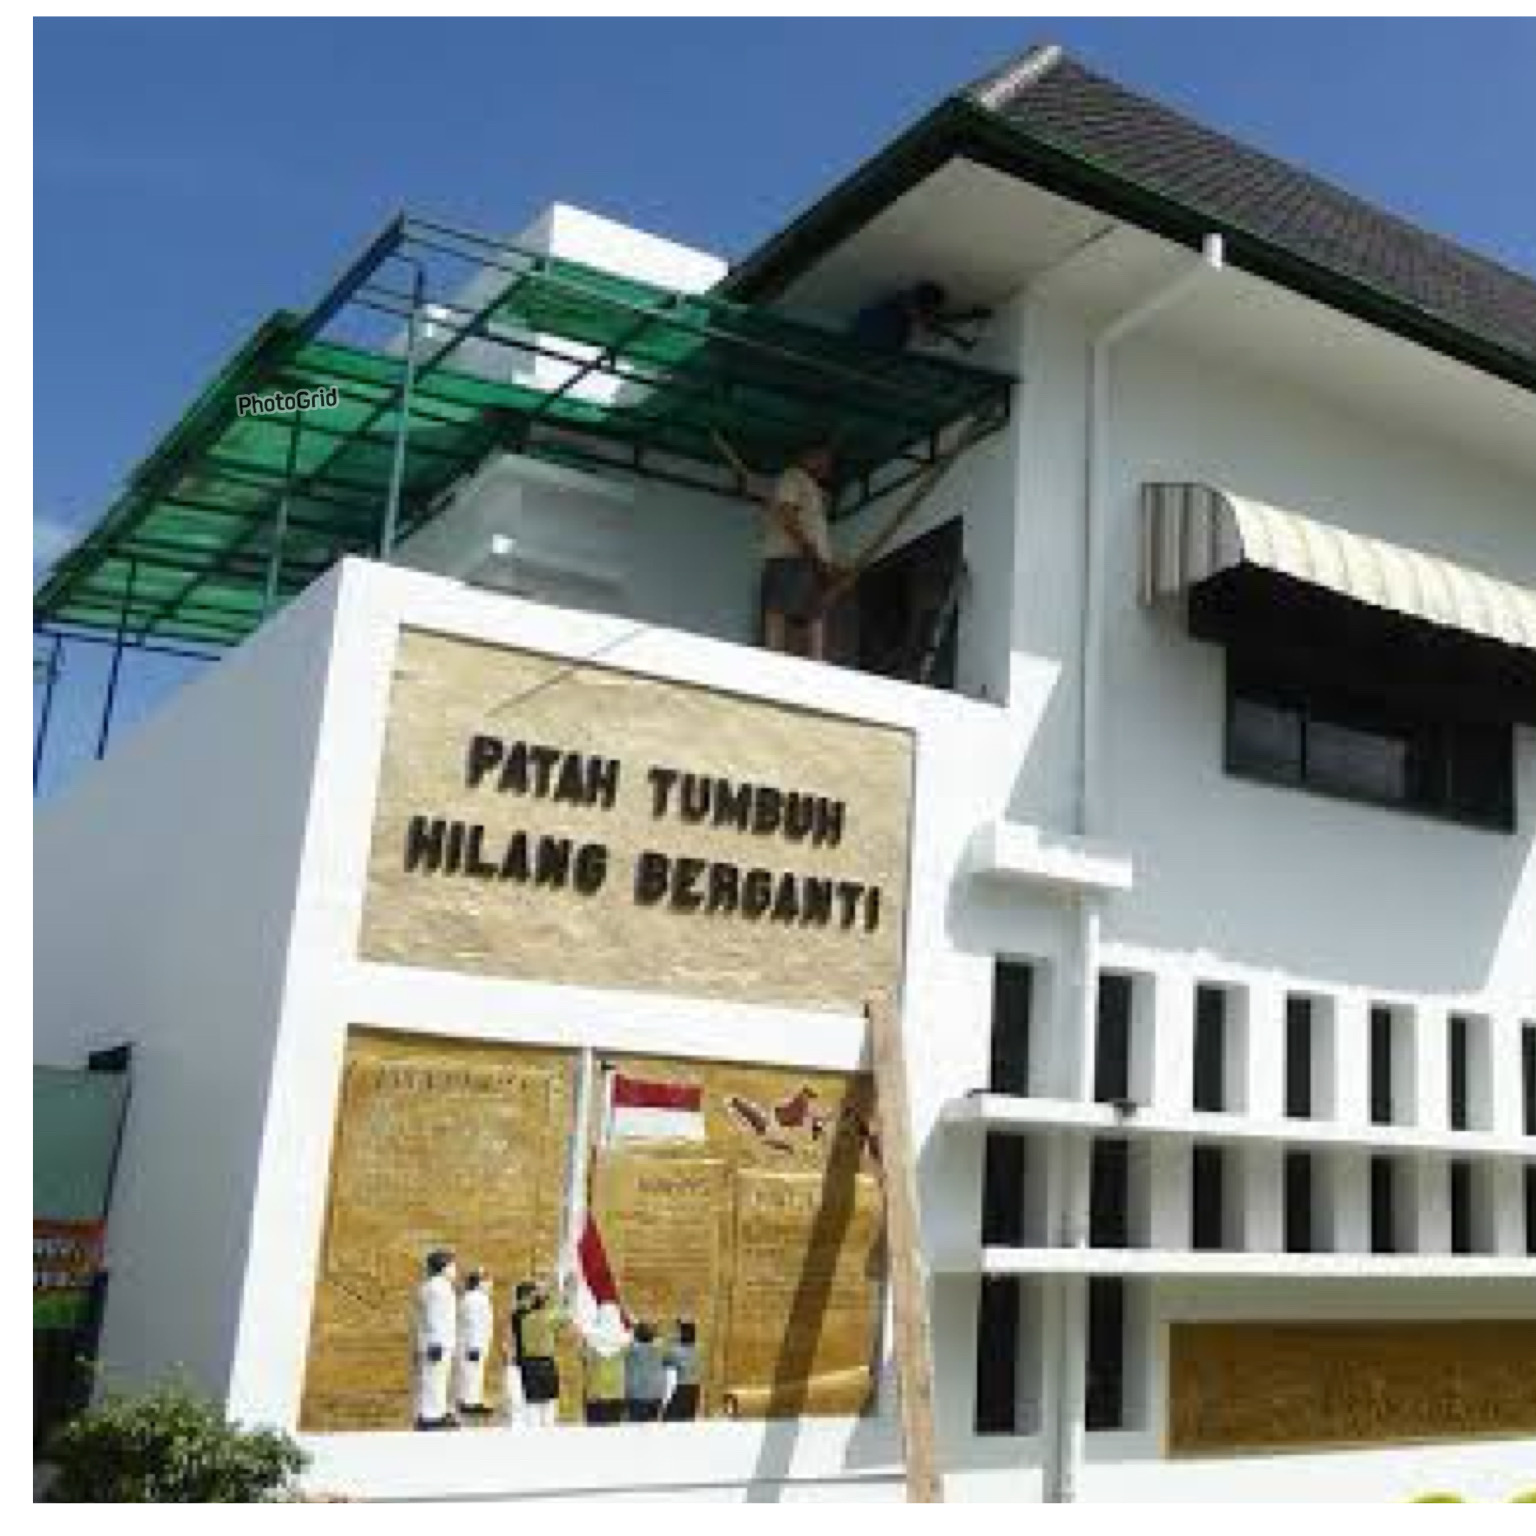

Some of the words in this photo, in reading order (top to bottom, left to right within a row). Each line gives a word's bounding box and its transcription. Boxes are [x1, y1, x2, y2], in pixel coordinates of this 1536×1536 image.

[464, 733, 621, 810] PATAH
[647, 765, 846, 849] TUMBUH
[403, 814, 609, 897] HILANG
[632, 850, 880, 934] BERGANTI
